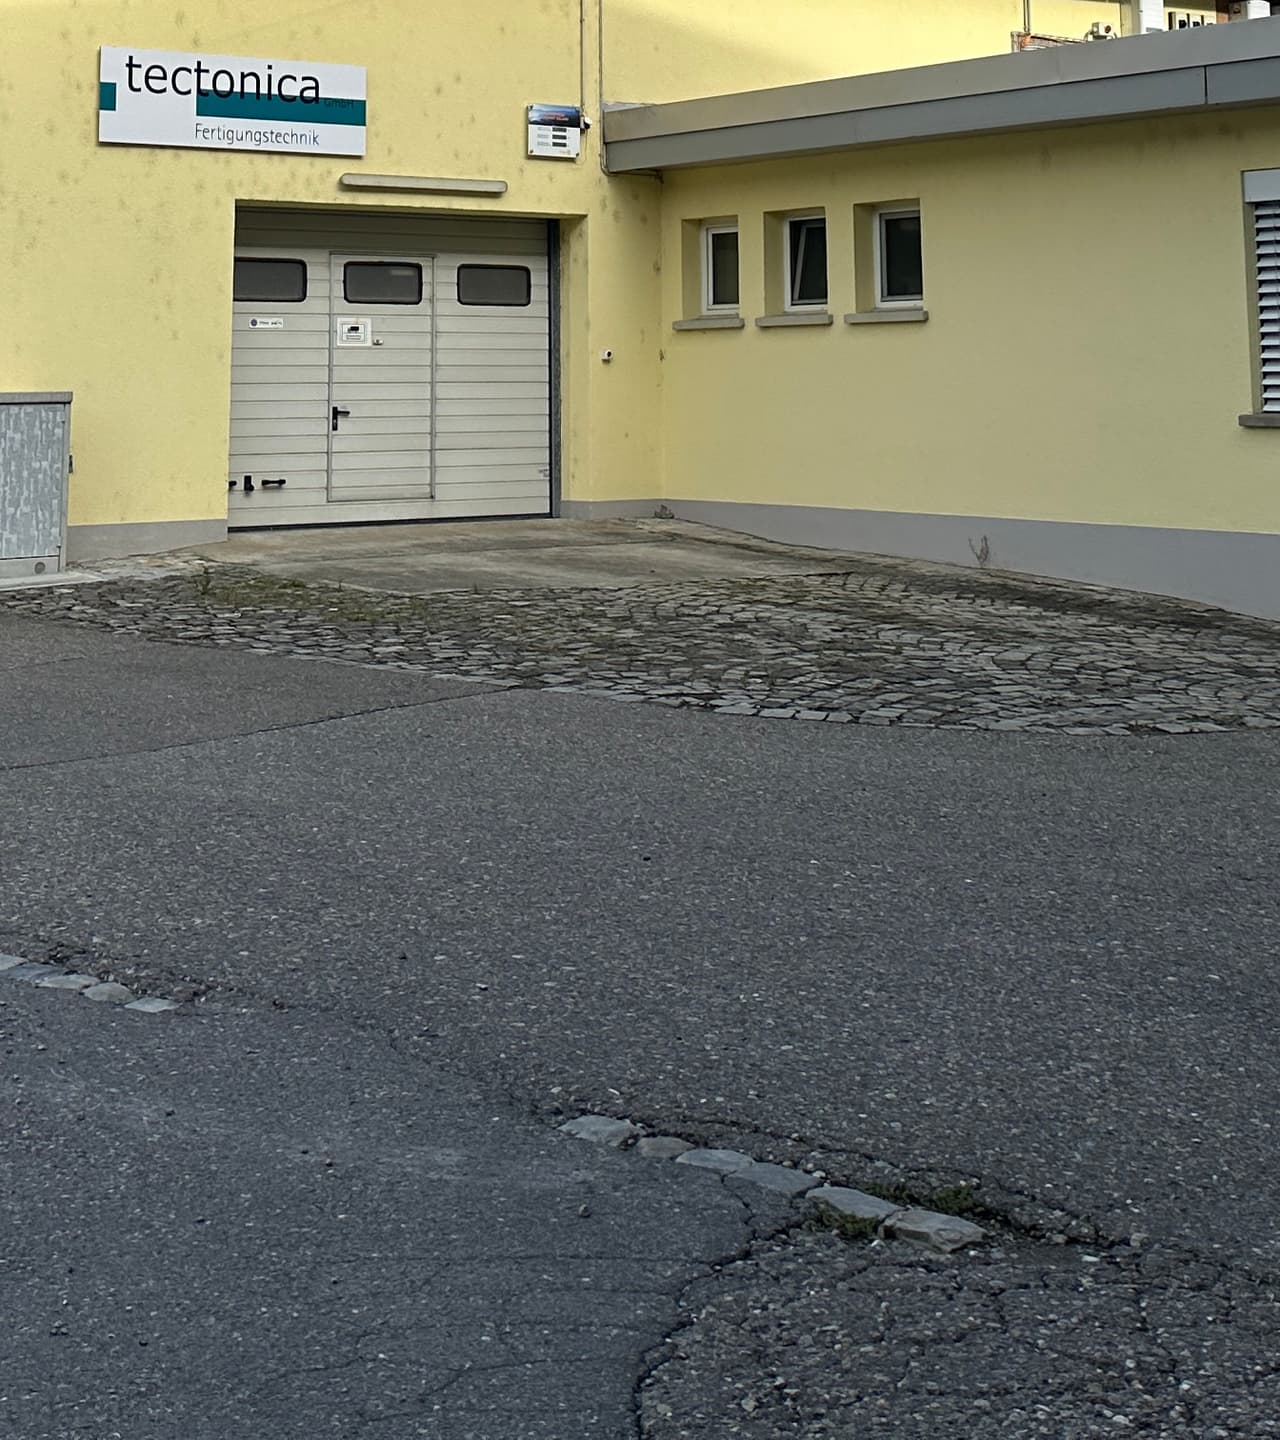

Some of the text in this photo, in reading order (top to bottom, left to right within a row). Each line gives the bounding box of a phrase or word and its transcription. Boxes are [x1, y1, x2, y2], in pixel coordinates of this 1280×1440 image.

[125, 55, 355, 110] tectonica GmbH
[195, 123, 320, 146] Fertigungstechnik
